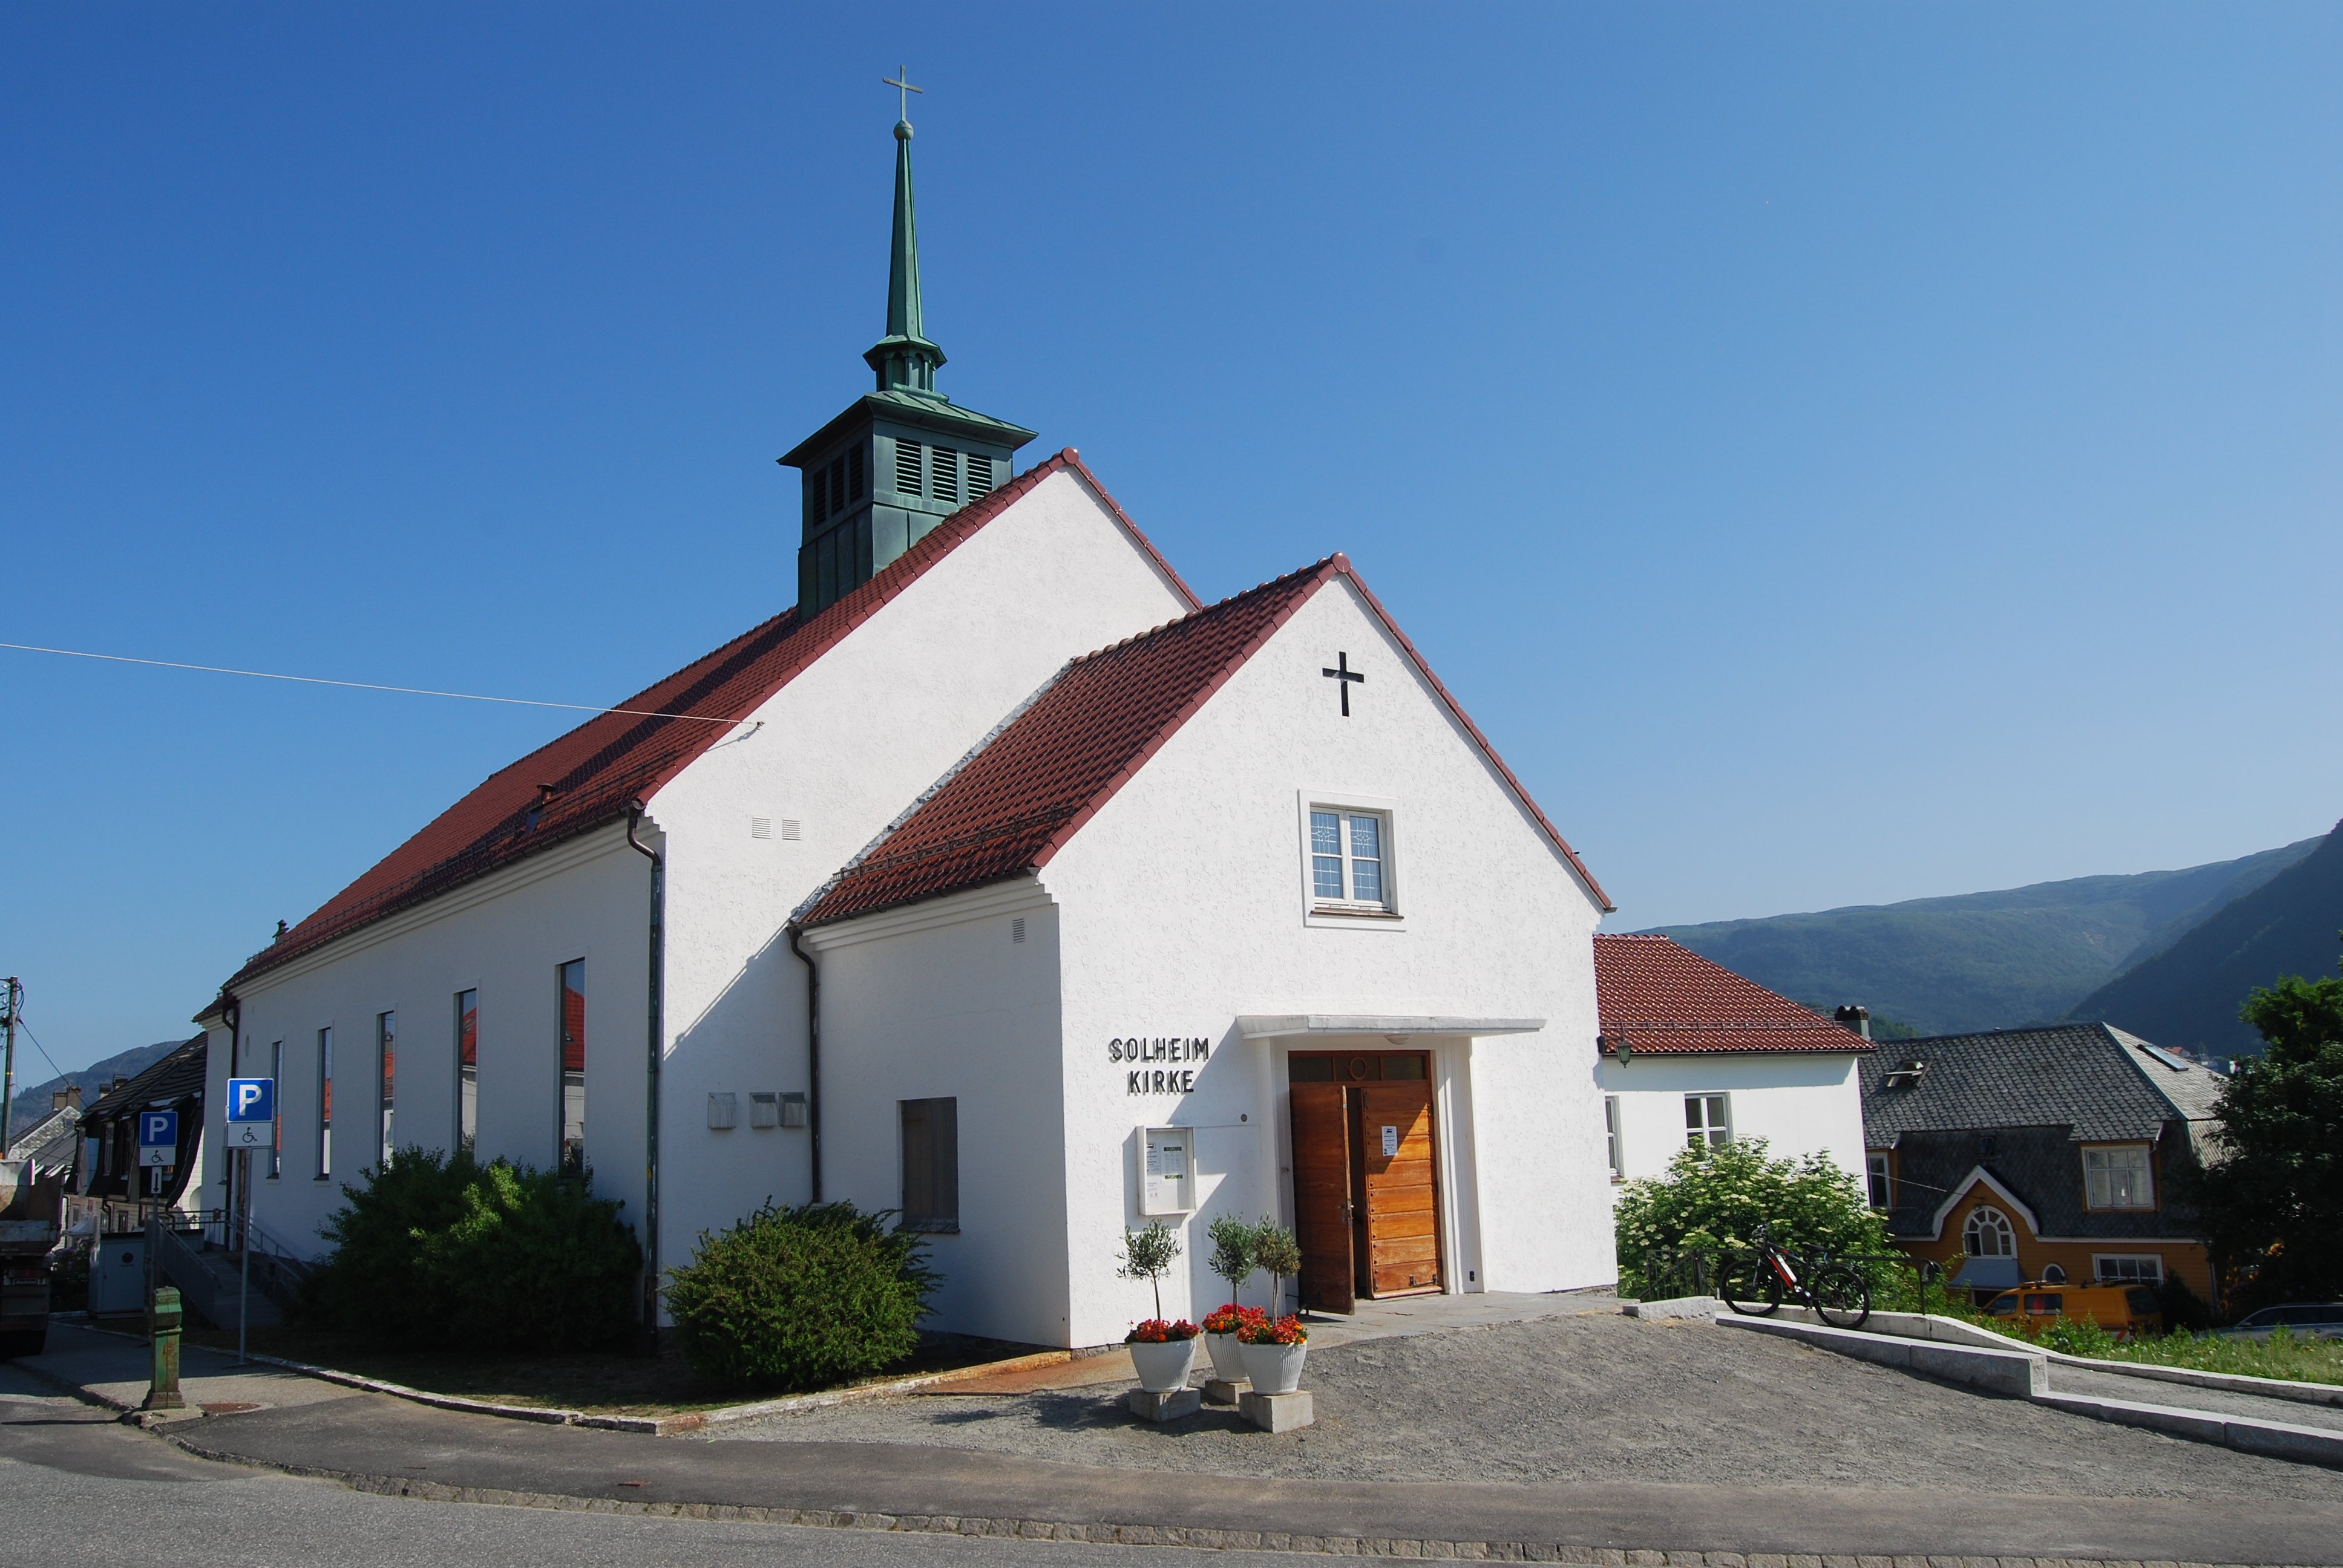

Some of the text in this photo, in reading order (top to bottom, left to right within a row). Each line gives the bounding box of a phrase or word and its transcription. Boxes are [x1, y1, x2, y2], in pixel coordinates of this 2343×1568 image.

[1112, 1037, 1209, 1060] SOLHEIM
[1130, 1070, 1194, 1093] KIRKE
[239, 1084, 262, 1116] P
[149, 1117, 168, 1142] P
